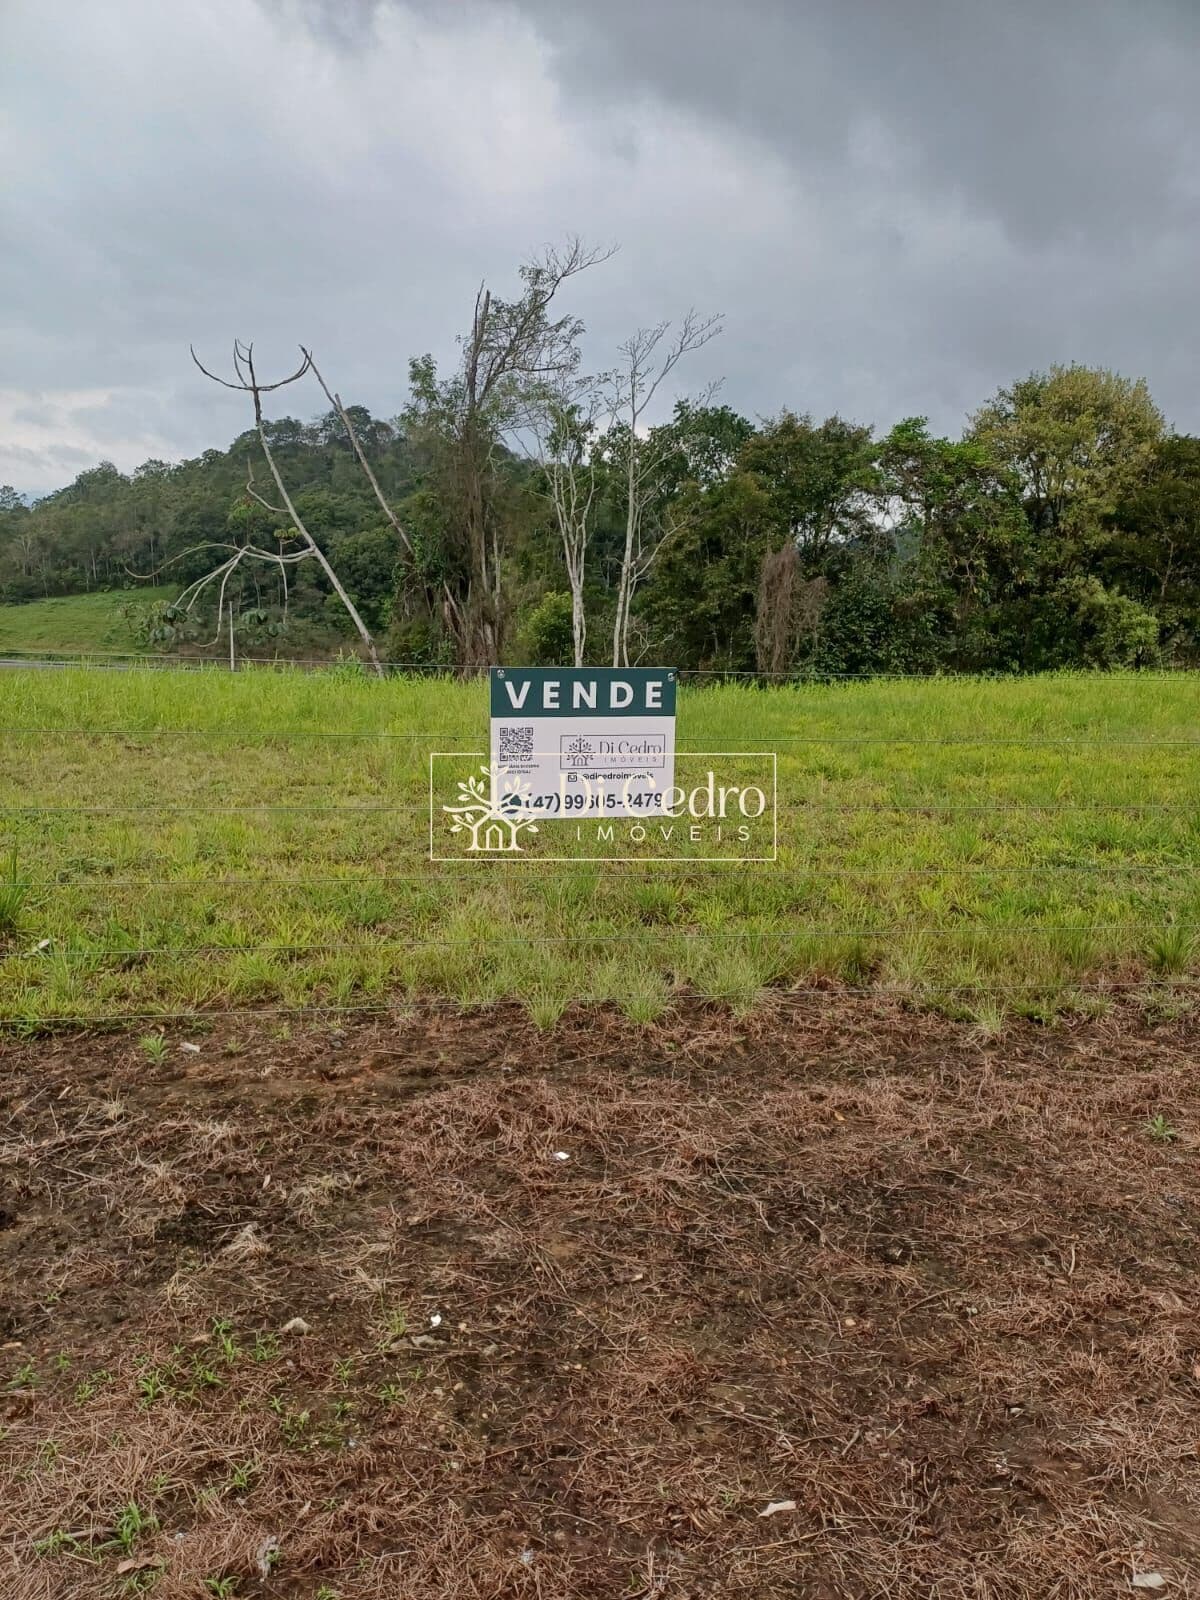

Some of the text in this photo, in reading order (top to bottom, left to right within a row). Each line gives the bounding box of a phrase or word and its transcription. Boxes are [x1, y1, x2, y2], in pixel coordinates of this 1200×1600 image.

[504, 680, 664, 709] VENDE
[599, 740, 662, 755] Di Cedro
